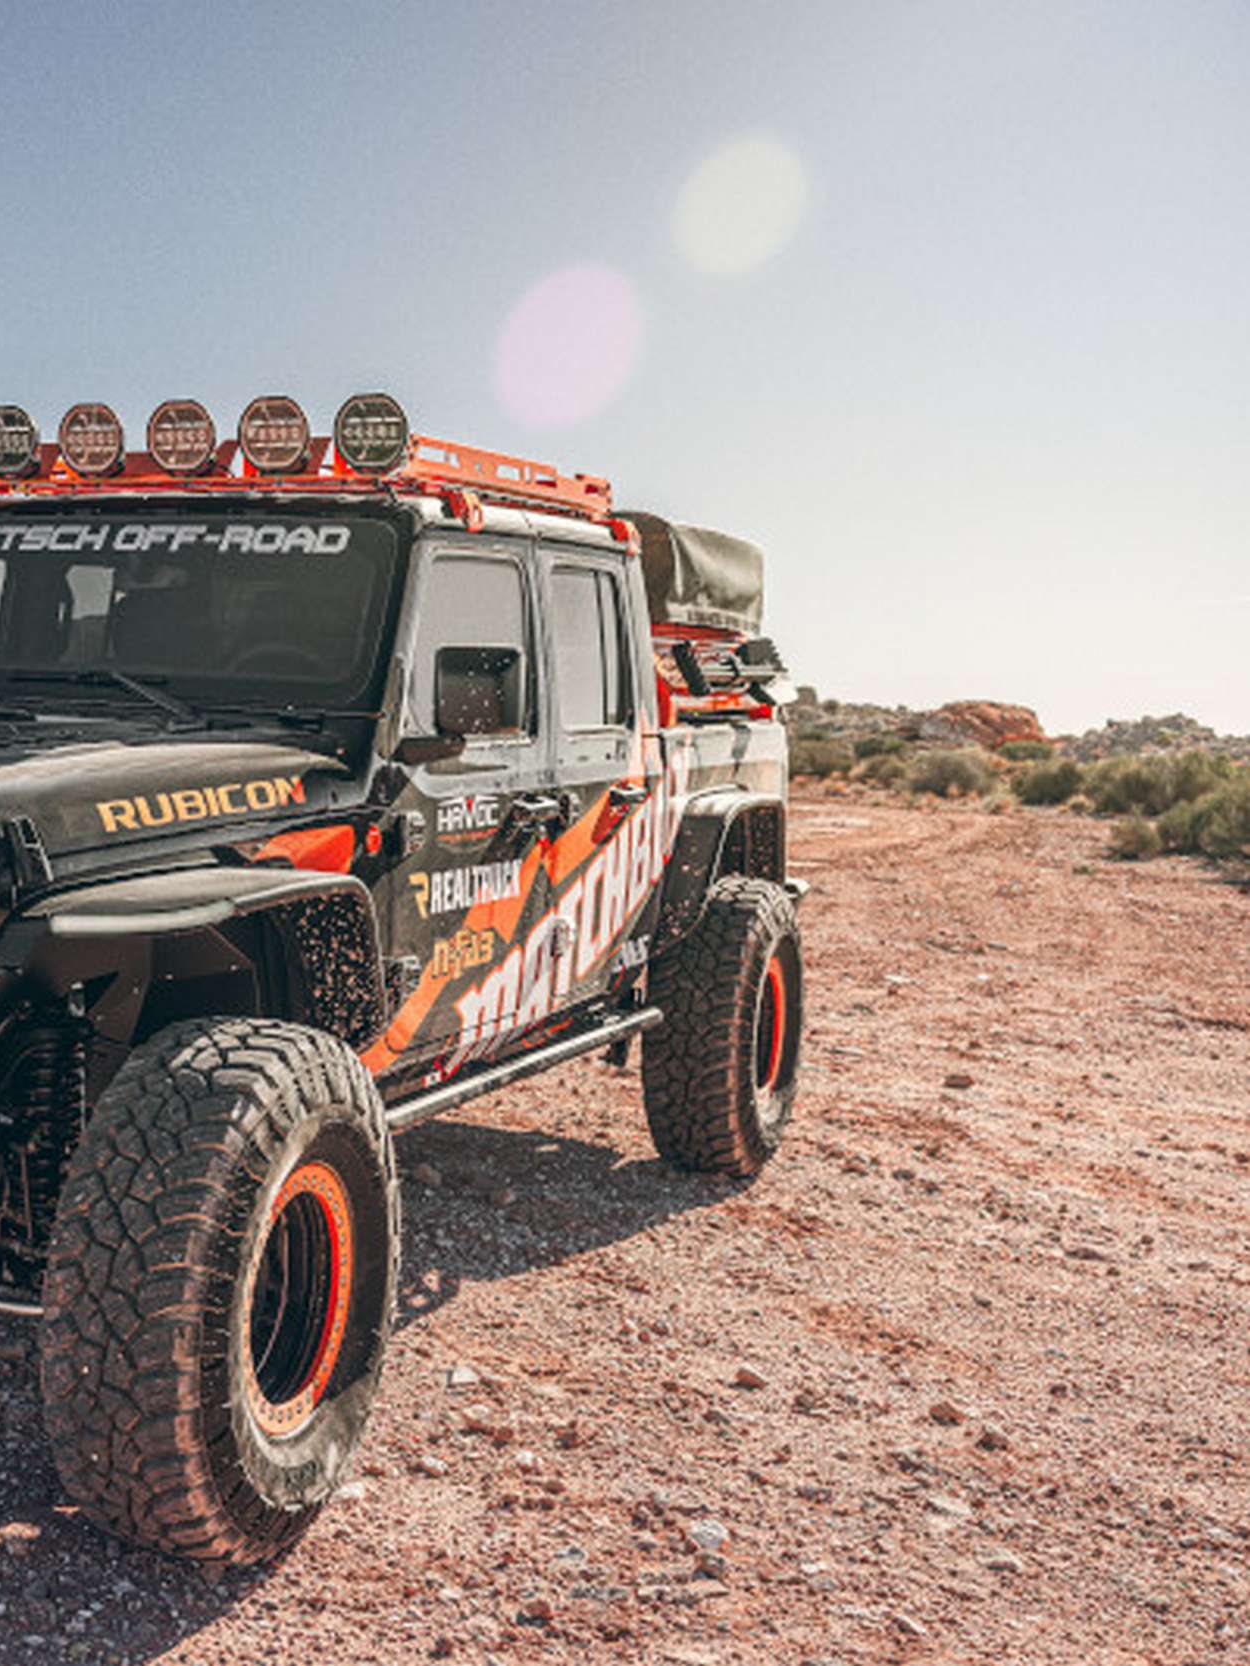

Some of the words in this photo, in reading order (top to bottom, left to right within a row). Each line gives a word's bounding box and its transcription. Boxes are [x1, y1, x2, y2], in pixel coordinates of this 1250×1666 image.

[112, 524, 351, 554] OFF-ROAD
[95, 774, 306, 833] RUBICON
[430, 859, 523, 914] REALTRUCK
